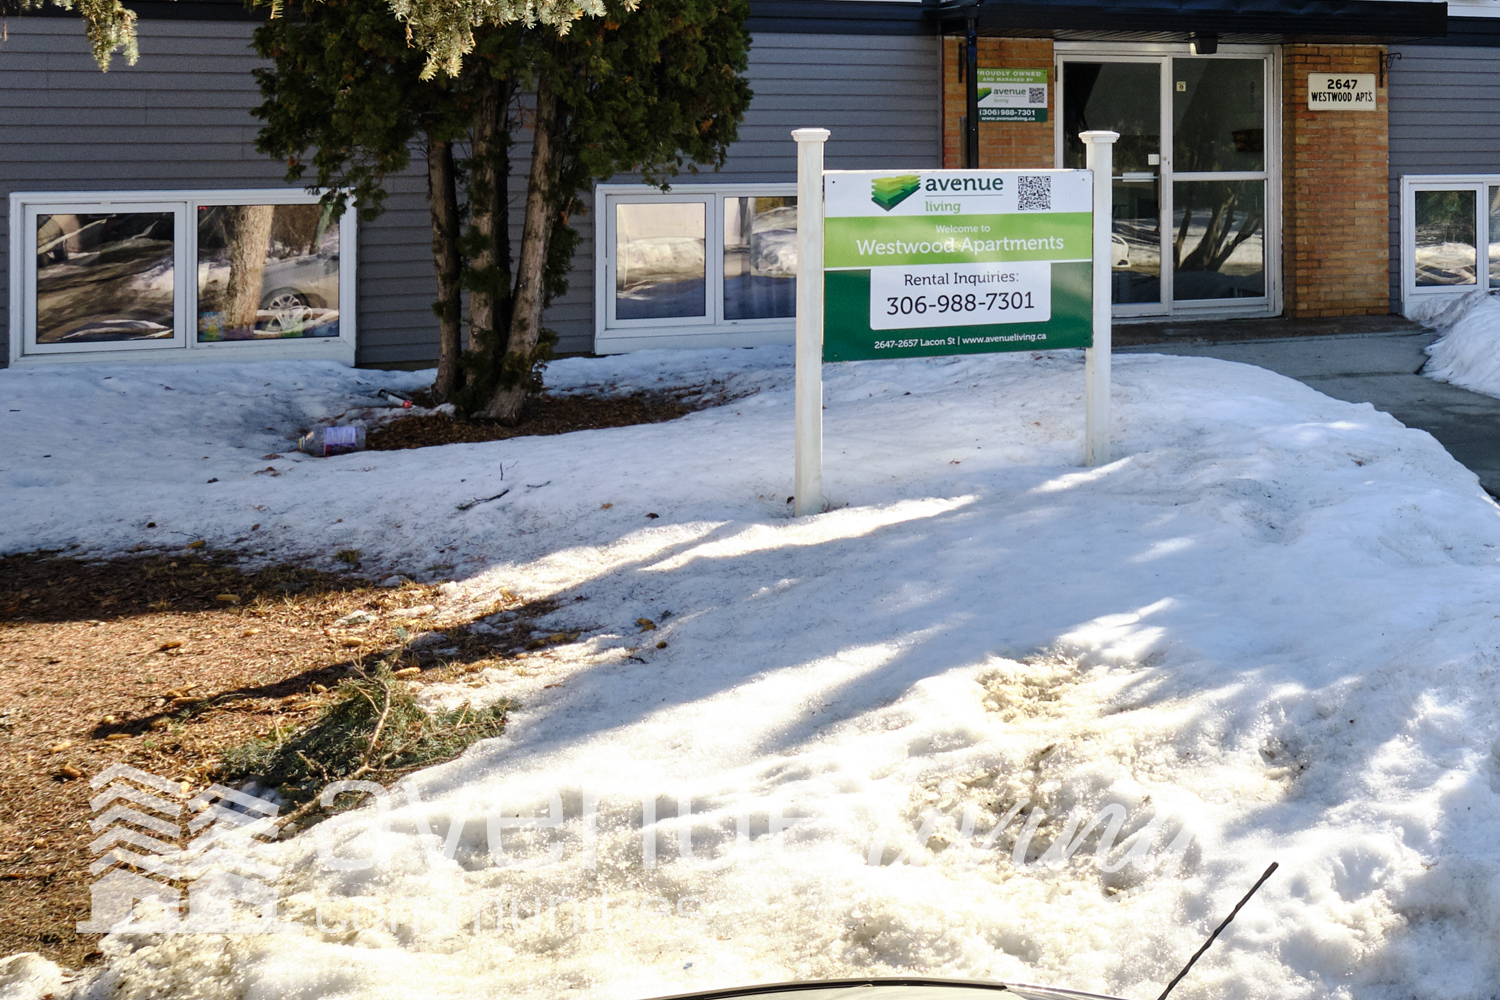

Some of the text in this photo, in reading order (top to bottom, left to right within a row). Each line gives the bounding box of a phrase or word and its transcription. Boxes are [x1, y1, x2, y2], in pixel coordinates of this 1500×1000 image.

[1327, 79, 1358, 90] 2647
[1311, 91, 1352, 102] WESTWOOD
[925, 176, 1004, 192] avenue
[925, 201, 961, 214] living
[935, 224, 991, 233] Welcome to
[856, 235, 1065, 256] Westwood Apartments
[904, 271, 1020, 287] Rental Inquiries:
[886, 291, 1035, 316] 306-988-7301
[874, 339, 918, 349] 2647-2657
[920, 337, 946, 347] Lacon
[947, 337, 956, 346] St
[961, 333, 1047, 345] www.avenueliving.ca
